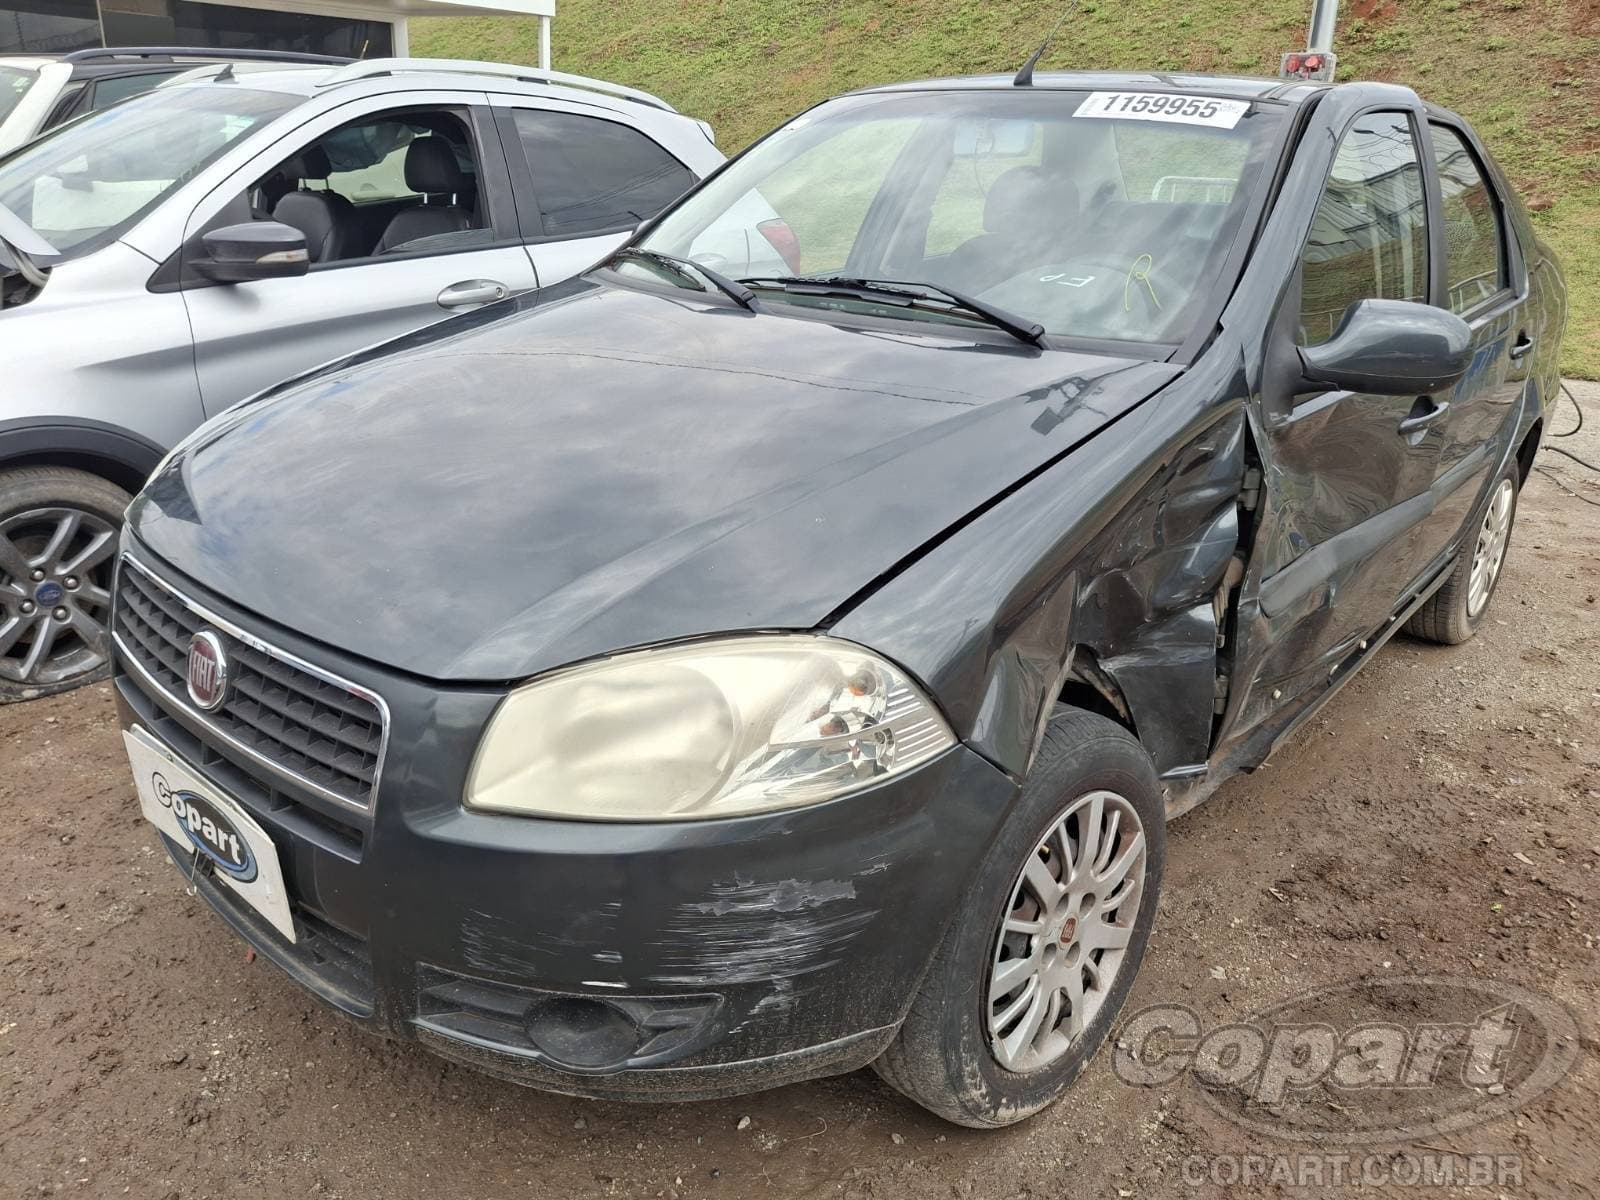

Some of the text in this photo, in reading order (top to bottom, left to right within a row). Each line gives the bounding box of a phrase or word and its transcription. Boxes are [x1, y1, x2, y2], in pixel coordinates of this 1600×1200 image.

[1103, 94, 1221, 118] 1159955
[193, 650, 216, 692] FIAT
[152, 771, 241, 866] Copart
